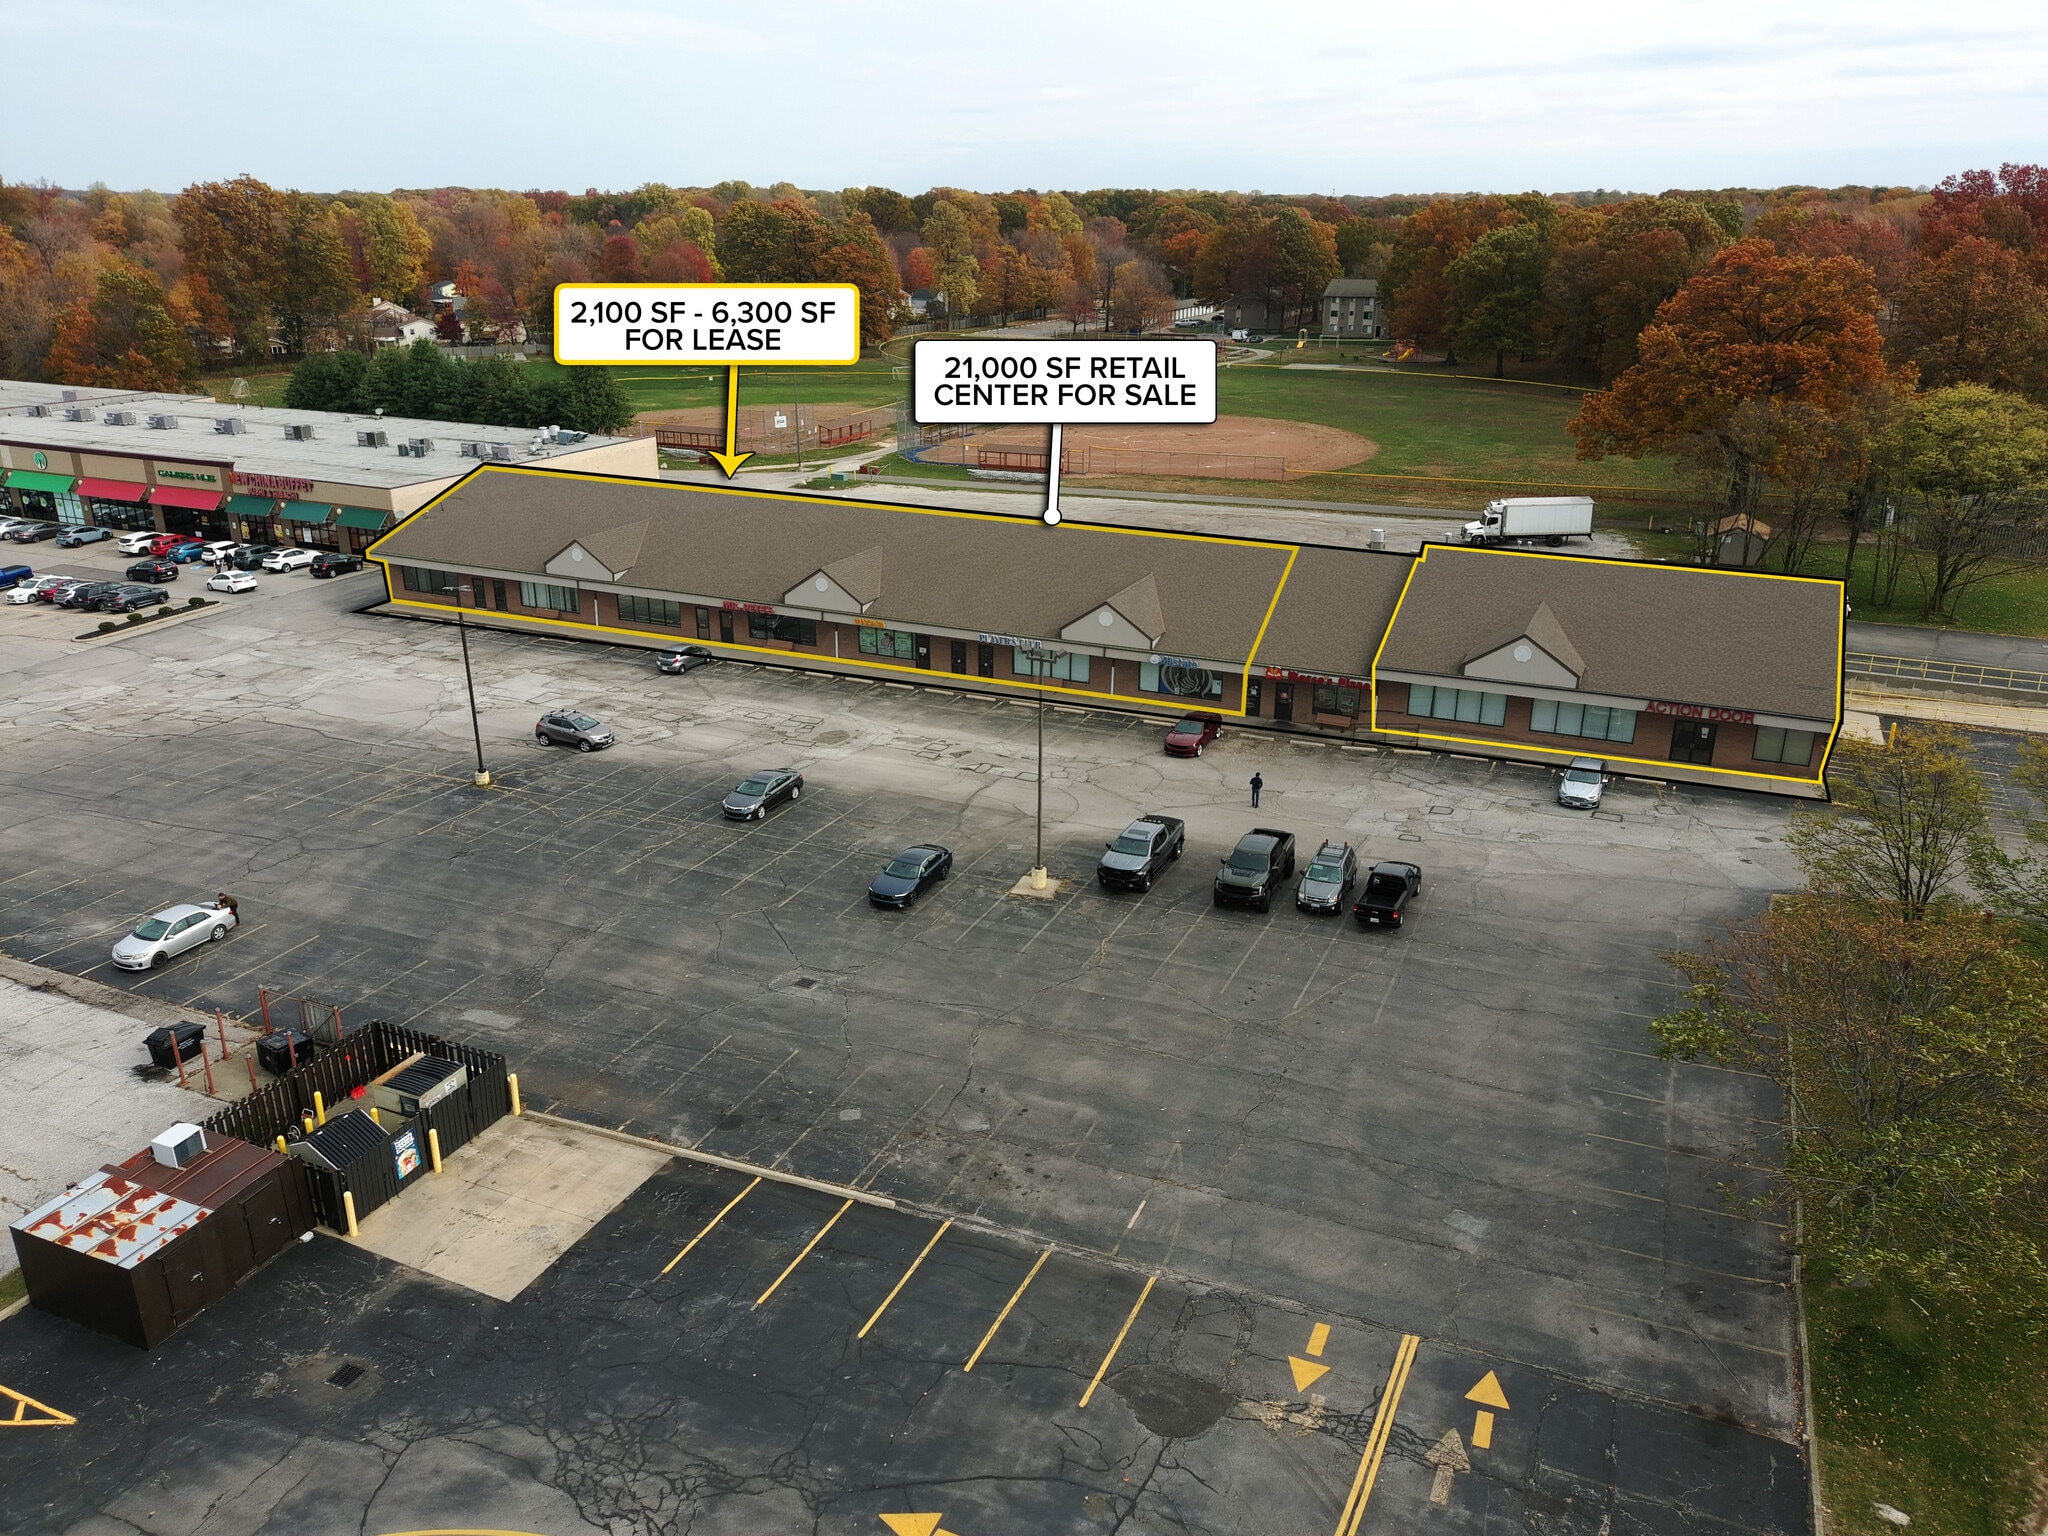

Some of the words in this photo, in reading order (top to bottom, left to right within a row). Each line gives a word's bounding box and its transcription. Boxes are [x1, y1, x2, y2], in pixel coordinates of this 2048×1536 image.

[228, 471, 247, 485] NEW
[249, 474, 277, 489] CHINA
[279, 477, 312, 492] BUFFET
[1646, 701, 1703, 718] ACTION
[1709, 708, 1755, 724] DOOR
